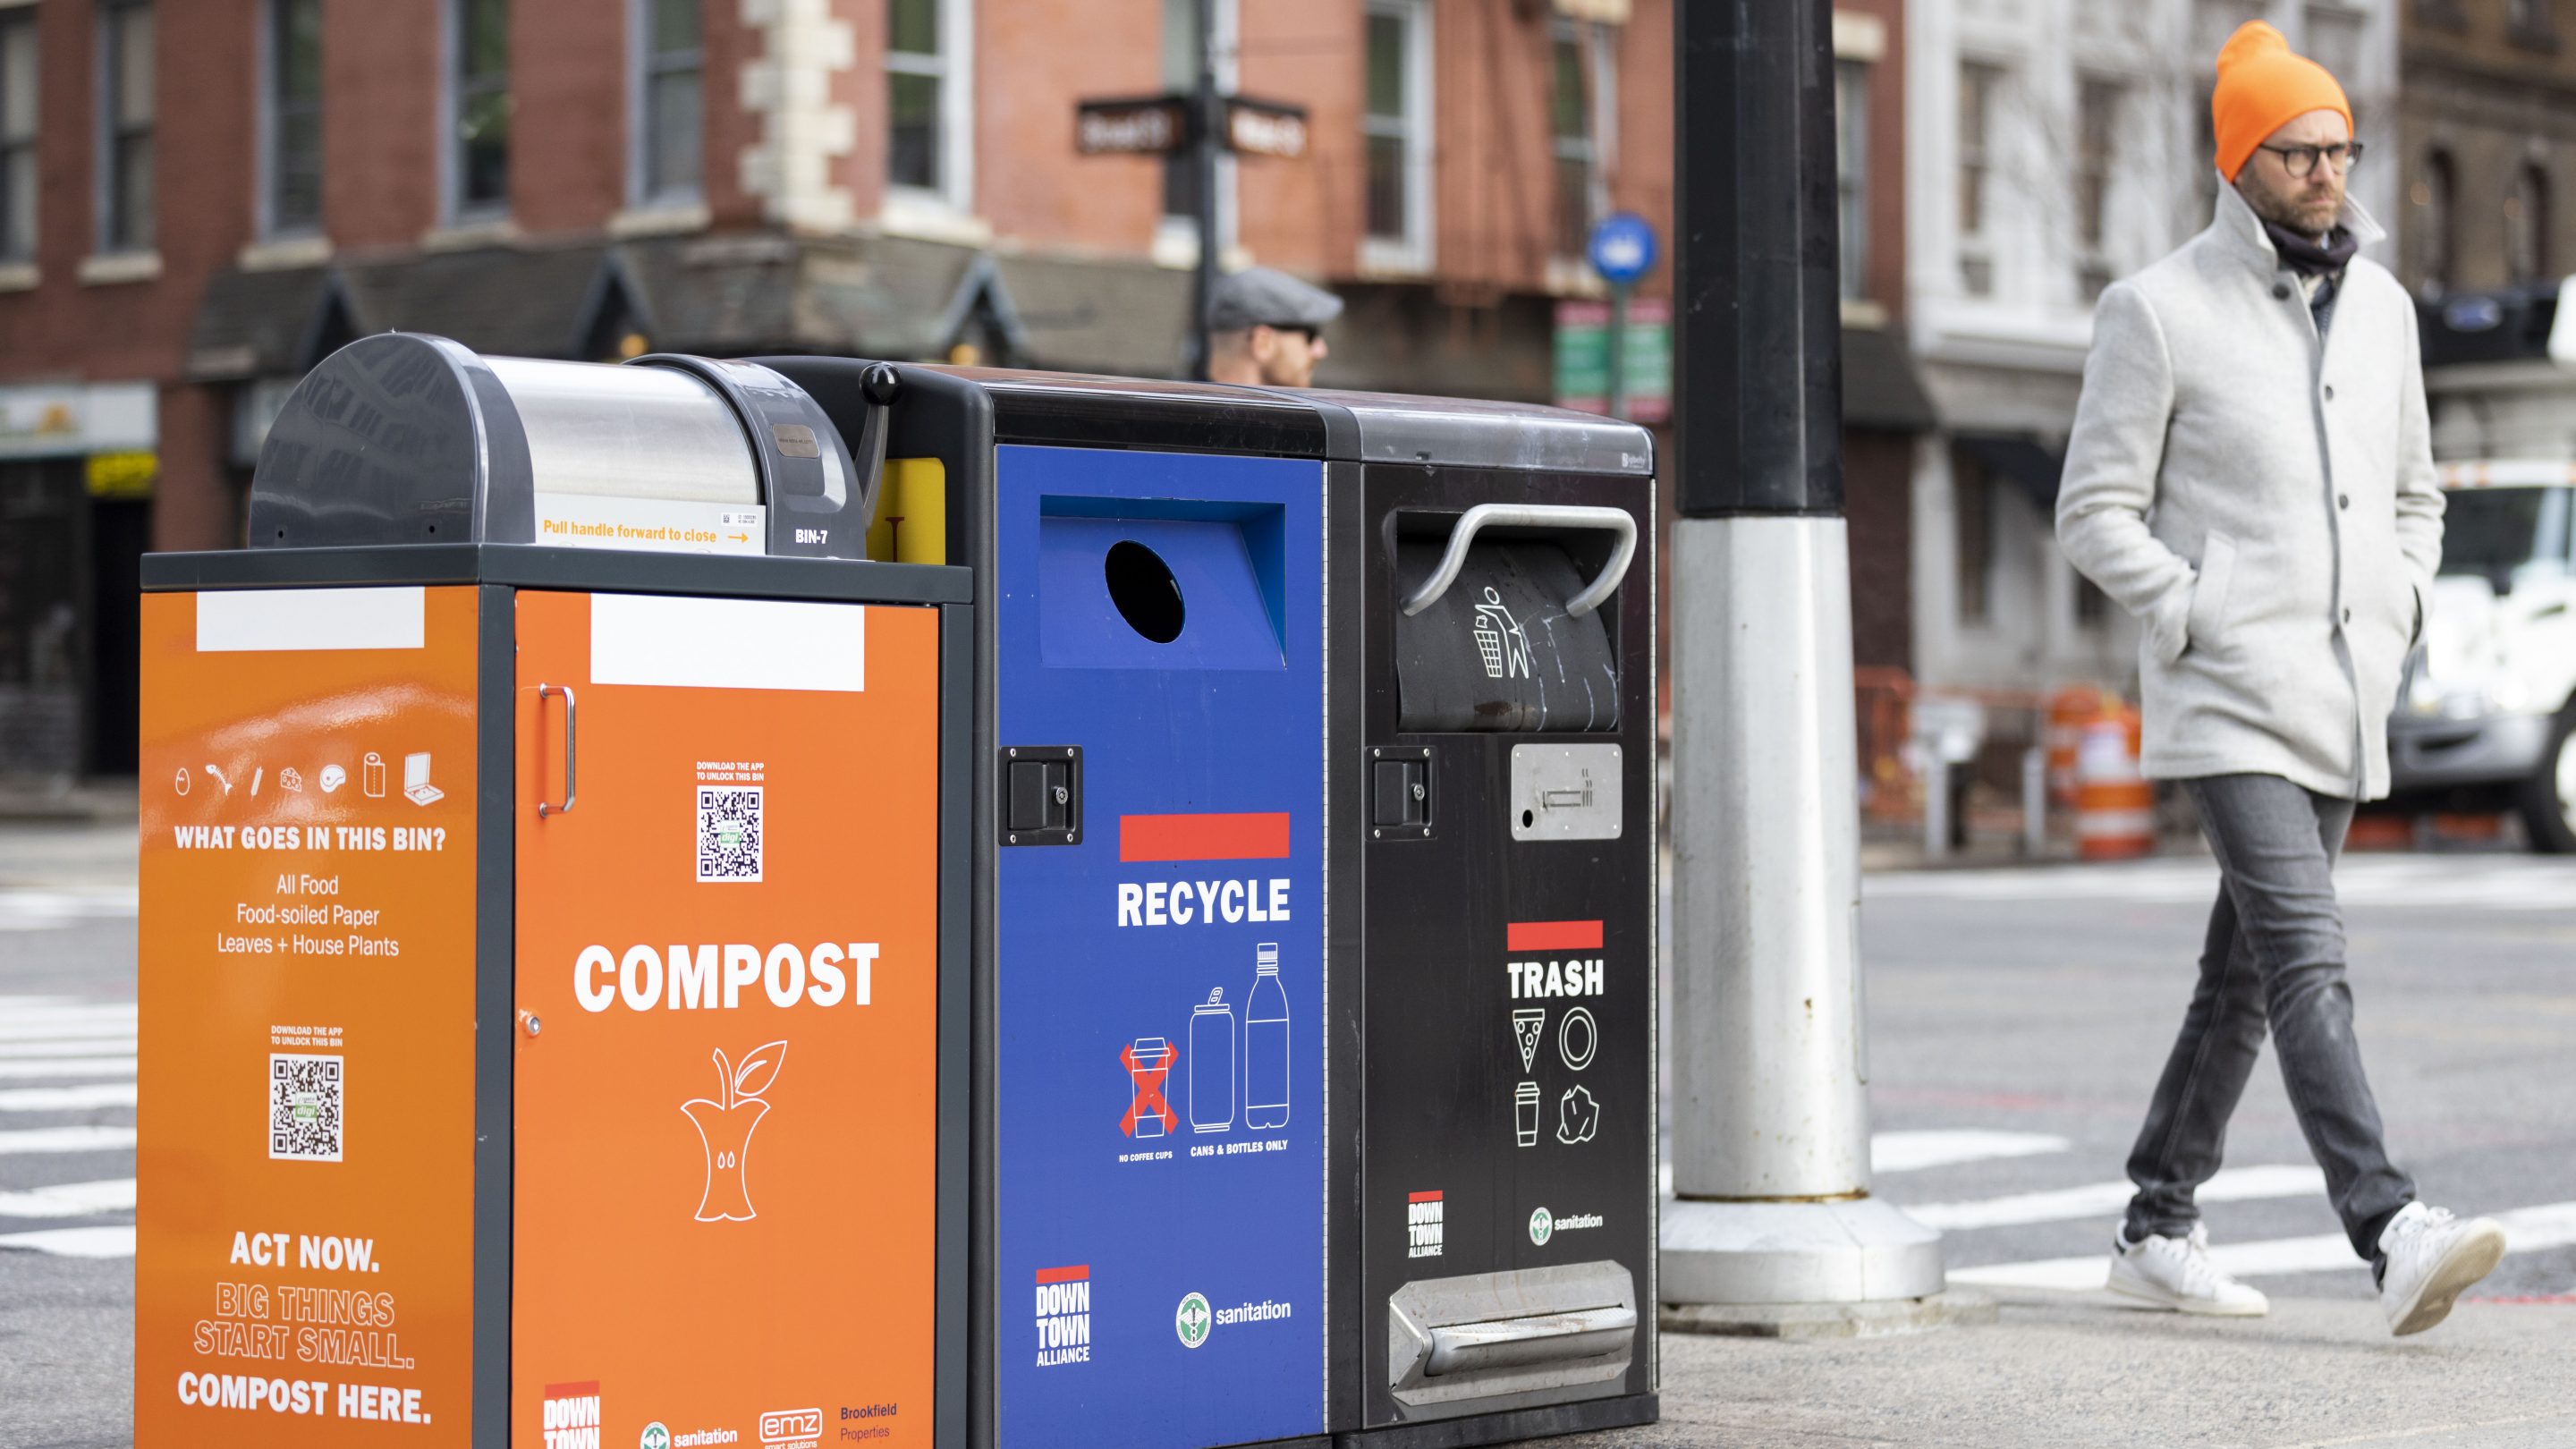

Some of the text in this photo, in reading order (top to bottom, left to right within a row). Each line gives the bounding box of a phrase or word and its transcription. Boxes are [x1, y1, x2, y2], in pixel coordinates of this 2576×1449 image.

[544, 519, 716, 543] Pull handle forward to close
[796, 529, 828, 544] BIN-7
[697, 762, 764, 771] DOWNLOAD THE APP
[735, 773, 750, 781] THIS
[752, 773, 764, 781] BIN
[174, 826, 445, 851] WHAT GOES IN THIS BIN?
[276, 874, 338, 894] All Food
[1118, 878, 1290, 927] RECYCLE
[238, 904, 379, 929] Food-soiled Paper
[218, 933, 399, 956] Leaves + House Plants
[573, 942, 880, 1013] COMPOST
[1507, 959, 1604, 998] TRASH
[272, 1026, 343, 1036] DOWNLOAD THE APP
[272, 1036, 343, 1046] TO UNLOCK THIS BIN
[1119, 1151, 1173, 1163] NO COFFEE CUPS
[1191, 1140, 1288, 1157] CANS & BOTTLES ONLY
[1409, 1201, 1443, 1225] DOWN
[1555, 1214, 1603, 1231] sanitation
[1408, 1223, 1443, 1247] TOWN
[230, 1232, 379, 1273] ACT NOW.
[1408, 1245, 1442, 1258] ALLIANCE
[216, 1283, 395, 1327] BIG THINGS
[1036, 1281, 1089, 1317] DOWN
[1216, 1300, 1291, 1326] sanitation
[1036, 1314, 1089, 1349] TOWN
[193, 1320, 415, 1369] START SMALL.
[1037, 1346, 1089, 1367] ALLIANCE
[178, 1371, 431, 1424] COMPOST HERE.
[544, 1395, 599, 1429] DOWN
[841, 1402, 896, 1420] Brookfield
[764, 1415, 818, 1436] emz
[841, 1425, 889, 1443] Properties
[674, 1428, 737, 1448] sanitation
[787, 1440, 818, 1449] solutions
